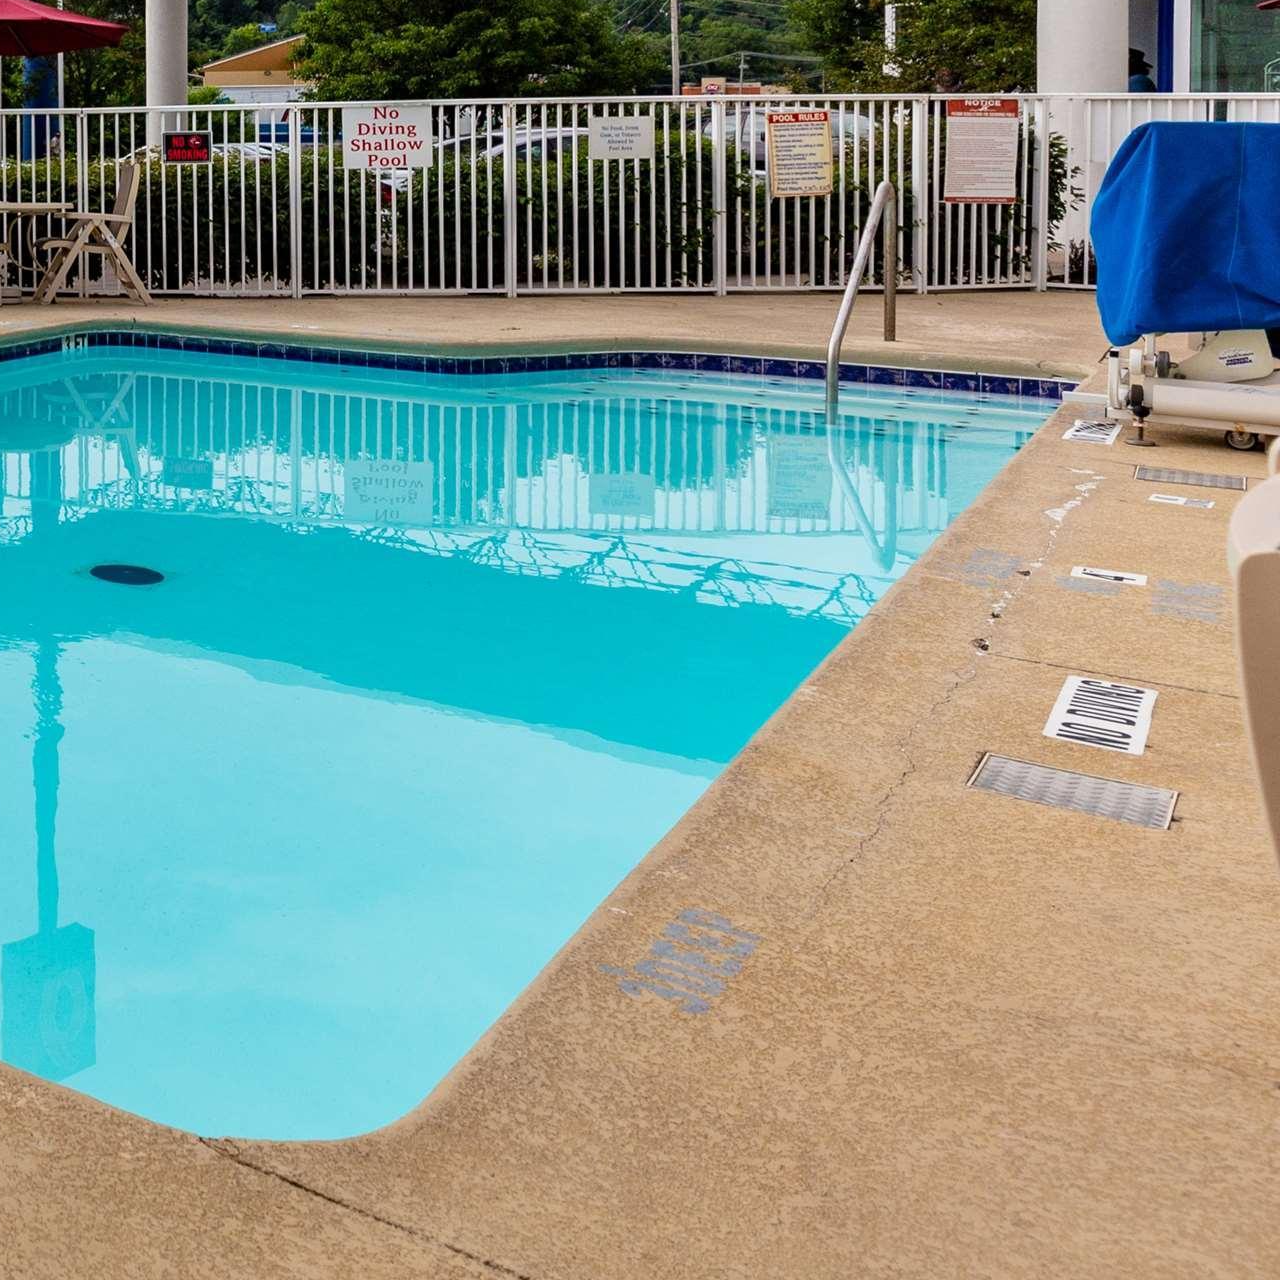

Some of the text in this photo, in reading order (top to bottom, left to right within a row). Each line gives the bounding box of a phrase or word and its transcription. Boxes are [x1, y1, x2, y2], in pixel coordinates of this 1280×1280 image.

[373, 106, 400, 119] No
[798, 113, 826, 121] RULES
[357, 122, 417, 137] Diving
[172, 136, 185, 147] NO
[350, 139, 424, 152] Shallow
[168, 149, 208, 160] SMOKING
[368, 154, 409, 167] Pool
[1065, 679, 1146, 727] DIVING
[1055, 721, 1133, 751] NO
